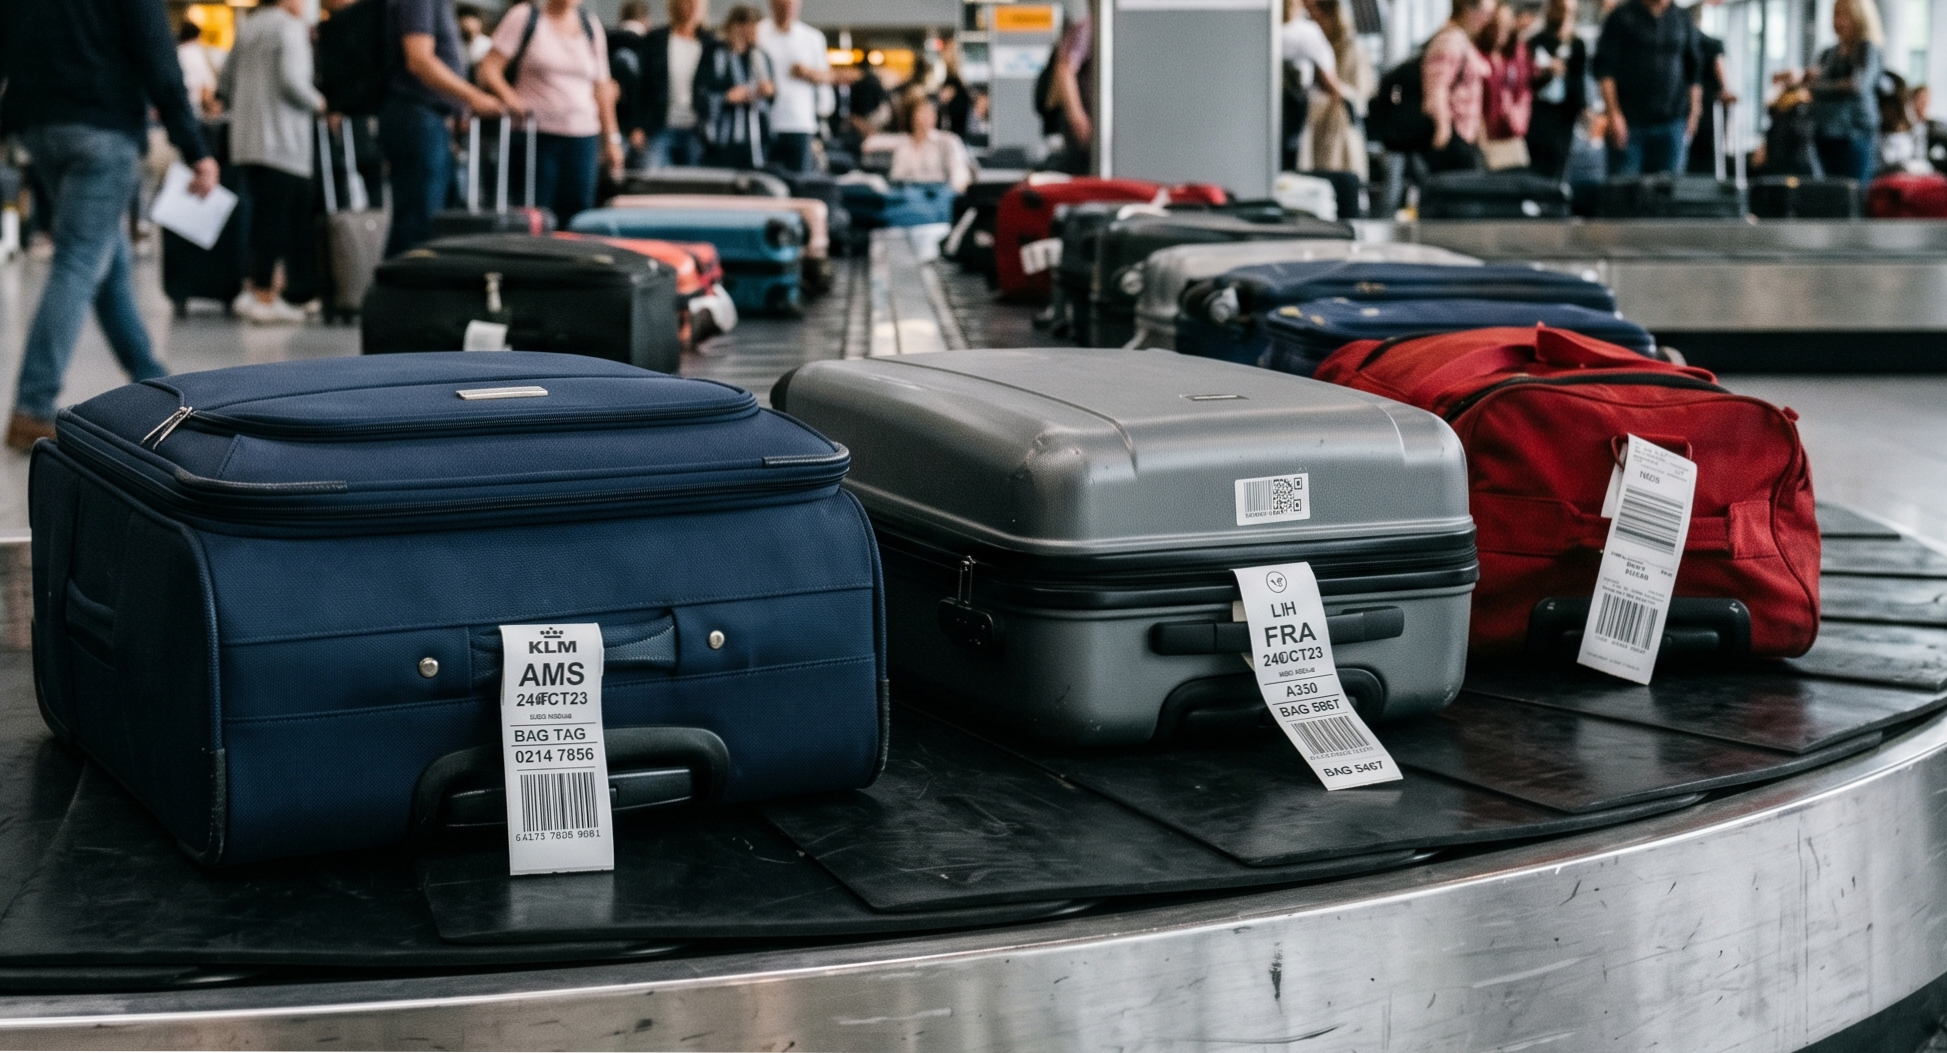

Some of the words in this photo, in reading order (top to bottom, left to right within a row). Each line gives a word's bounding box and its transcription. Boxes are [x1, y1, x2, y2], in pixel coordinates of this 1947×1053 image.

[1264, 622, 1317, 648] FRA
[528, 640, 577, 654] KLM
[518, 661, 585, 687] AMS
[1286, 682, 1318, 697] A350
[1279, 704, 1310, 718] BAG
[514, 729, 549, 743] BAG
[553, 727, 586, 741] TAG
[515, 750, 553, 764] 0214
[557, 747, 594, 762] 7856
[1323, 765, 1353, 777] BAG
